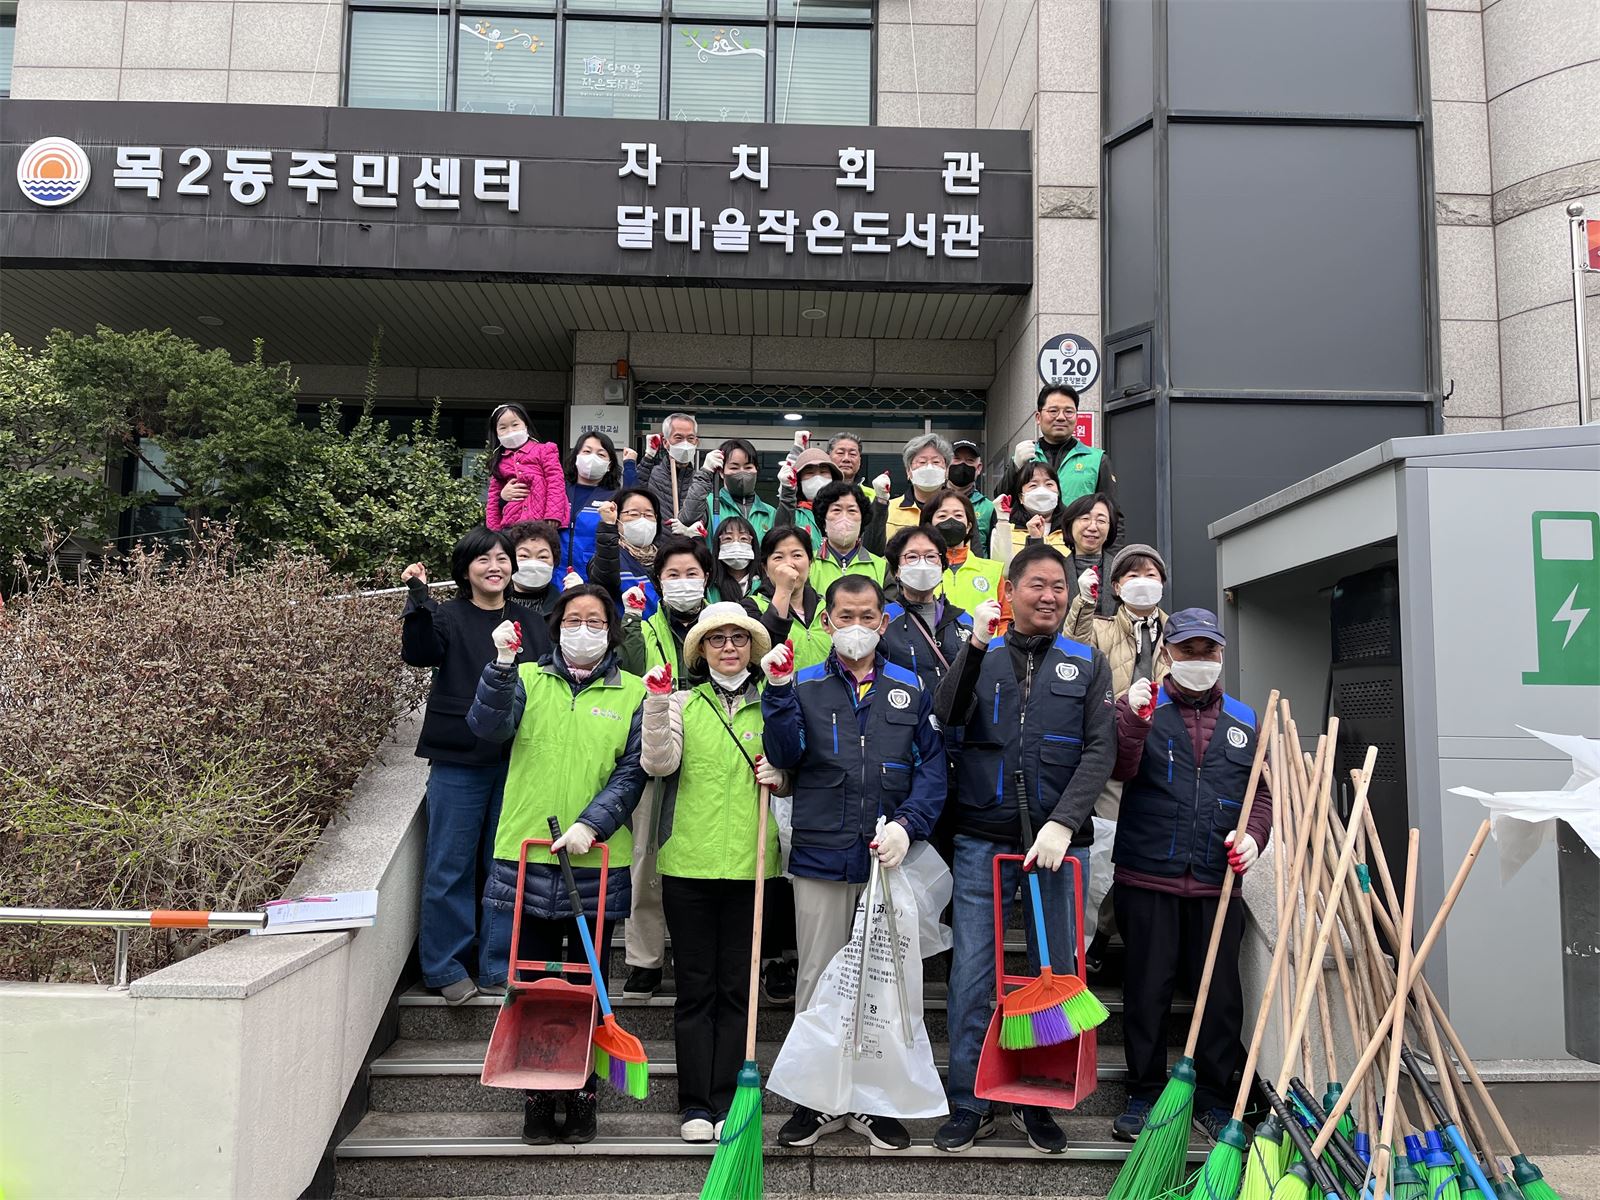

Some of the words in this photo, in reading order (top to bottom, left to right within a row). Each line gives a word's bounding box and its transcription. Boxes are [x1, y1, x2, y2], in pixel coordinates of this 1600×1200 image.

[113, 146, 520, 213] 목2동주민센터
[616, 205, 985, 258] 달마을작은도서관
[1049, 357, 1092, 377] 120
